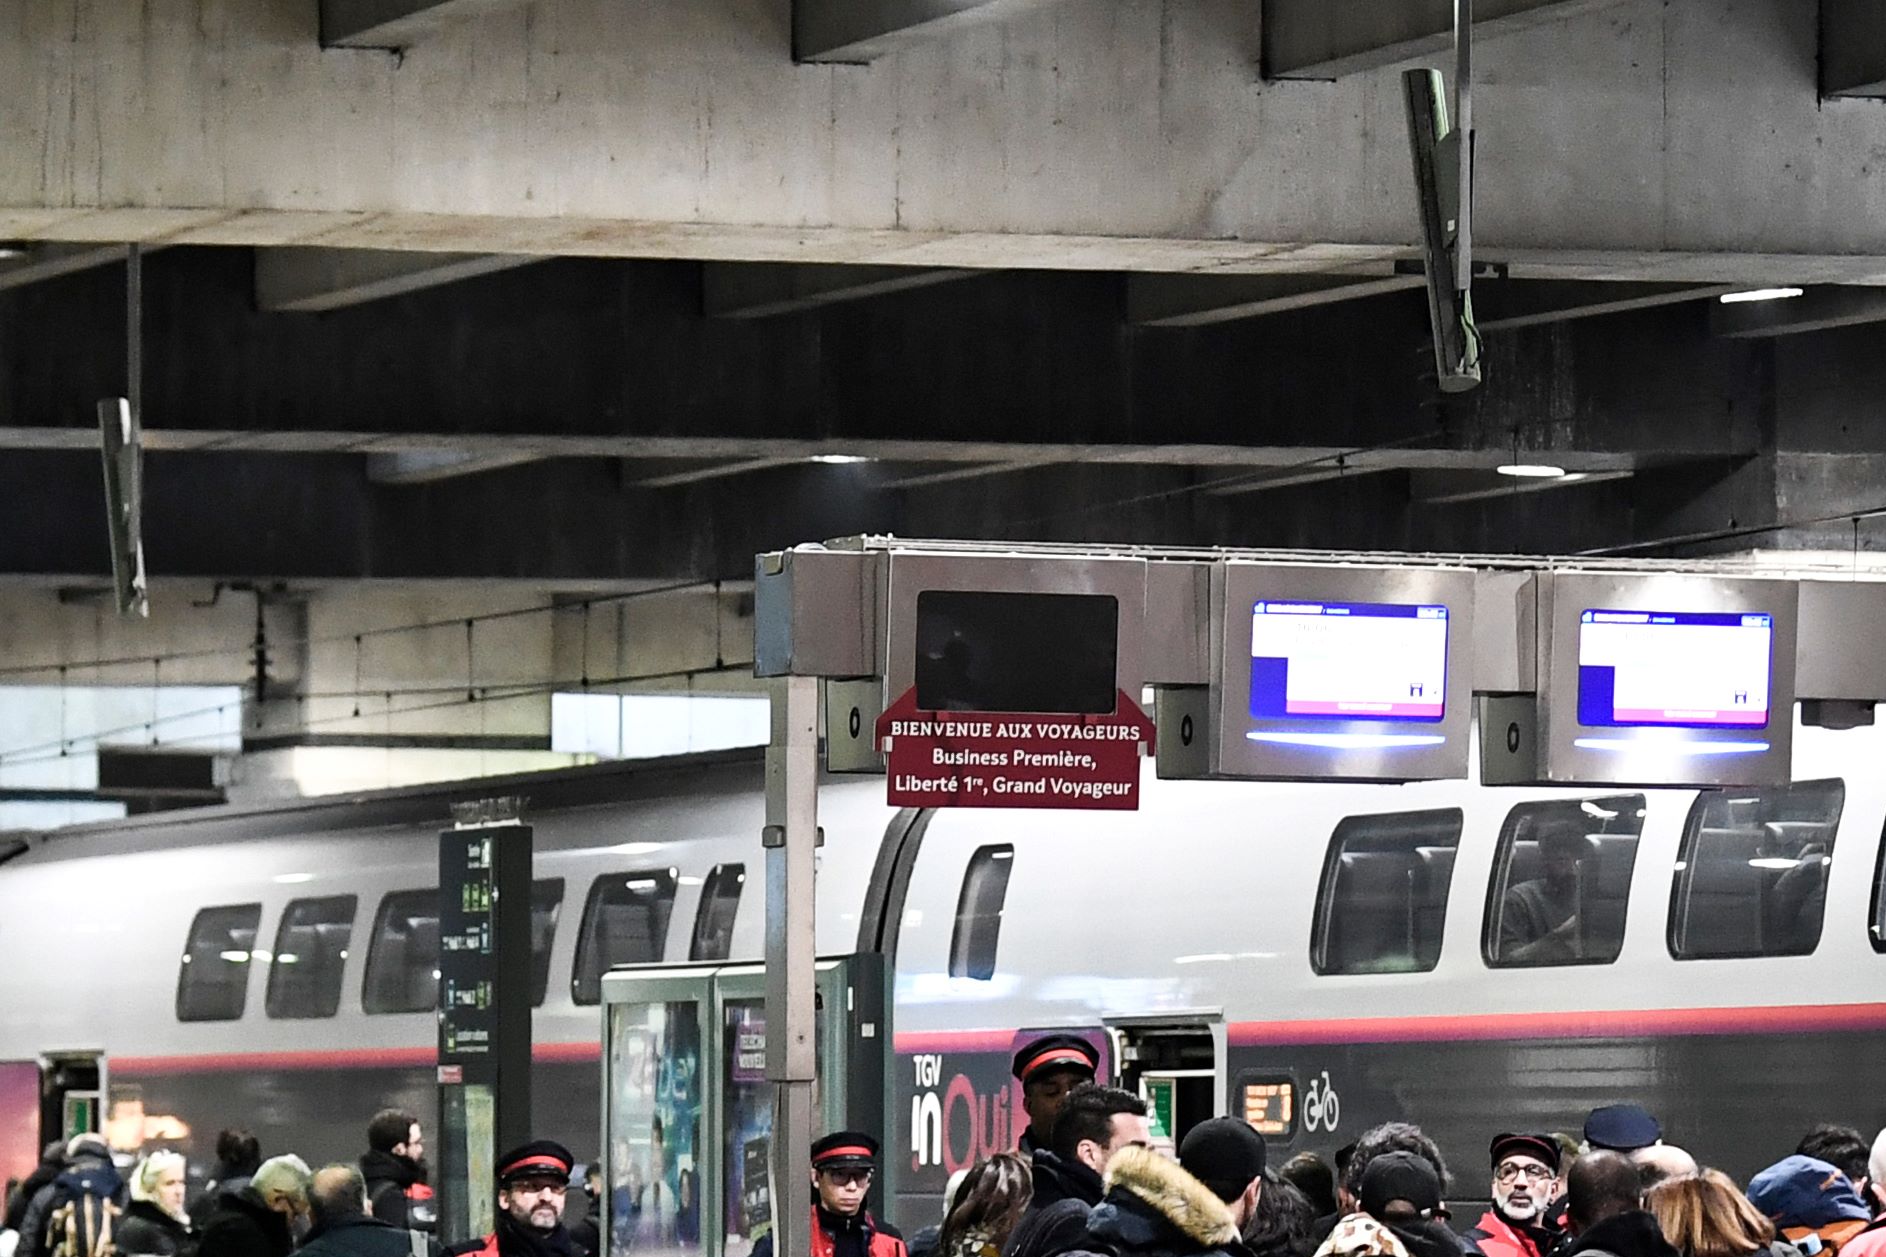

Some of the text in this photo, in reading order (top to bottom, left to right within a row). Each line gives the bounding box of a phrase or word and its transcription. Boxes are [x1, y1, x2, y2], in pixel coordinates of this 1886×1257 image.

[891, 721, 1140, 741] BIENVENUE AUX VOYAGEURS
[932, 748, 1097, 770] Business Première,
[895, 775, 957, 792] Liberté
[993, 777, 1045, 794] Grand
[1050, 778, 1132, 798] Voyageur
[912, 1054, 942, 1087] TGV
